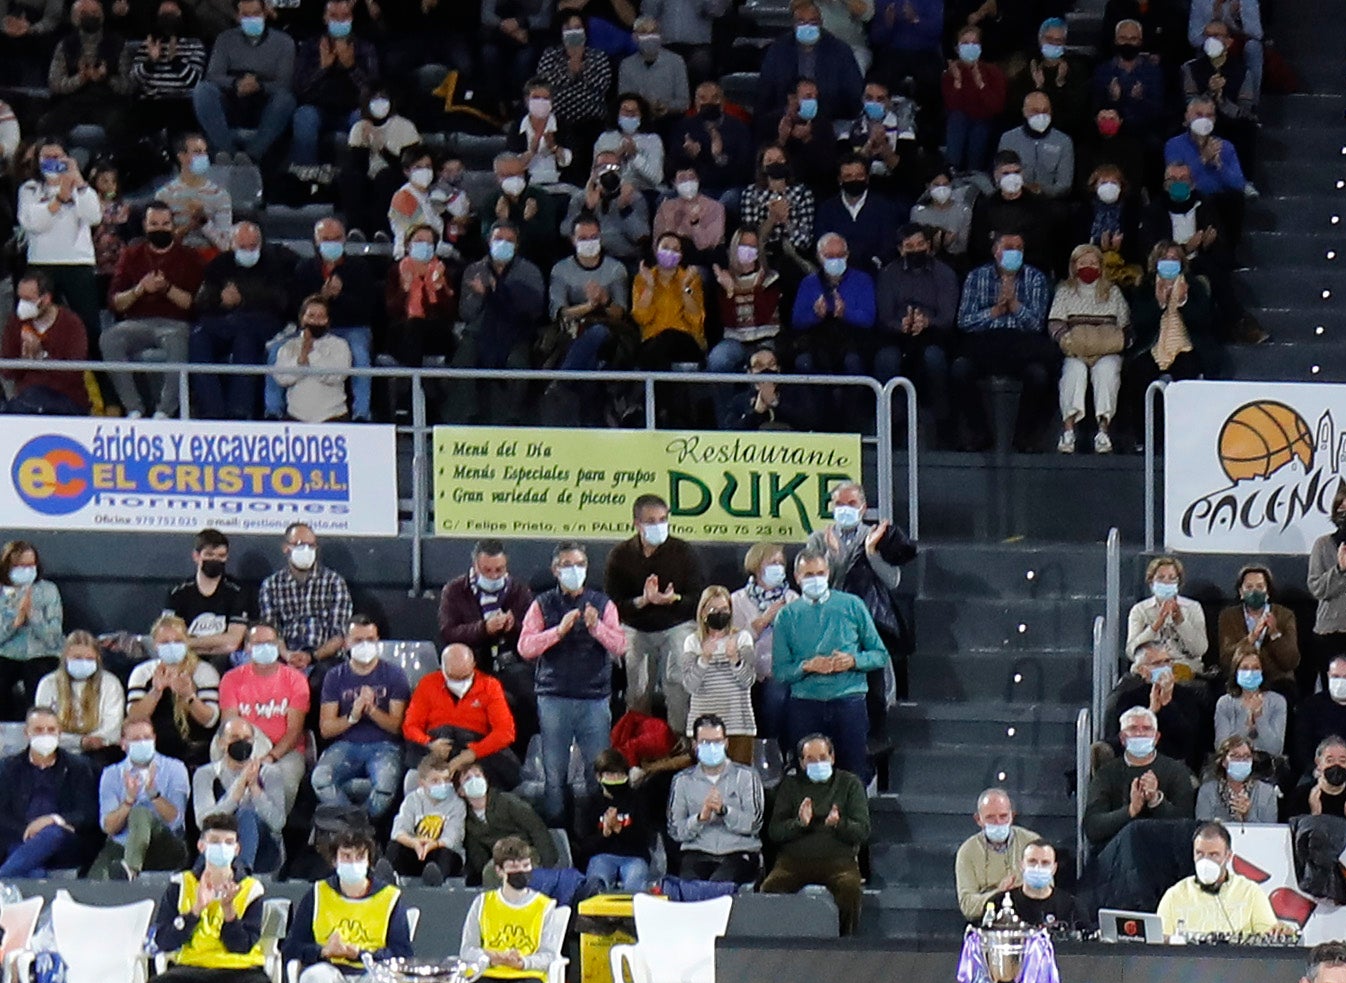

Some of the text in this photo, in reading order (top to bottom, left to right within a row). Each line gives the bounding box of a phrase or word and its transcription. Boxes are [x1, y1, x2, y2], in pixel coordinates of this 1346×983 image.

[93, 425, 163, 462] áridos
[190, 428, 348, 463] excavaciones
[452, 441, 552, 457] Menú del Día
[666, 436, 851, 468] Restaurante
[93, 463, 136, 490] EL
[452, 464, 657, 489] Menús Especiales para grupos
[93, 493, 350, 514] hormigones
[453, 487, 627, 511] Gran variedad de picoteo
[668, 470, 854, 535] DUKE
[442, 519, 635, 534] C/ Felipe Prieto, s/n PALEN
[703, 524, 728, 535] 979
[734, 524, 750, 535] 75
[755, 525, 772, 536] 23
[778, 525, 794, 536] 61
